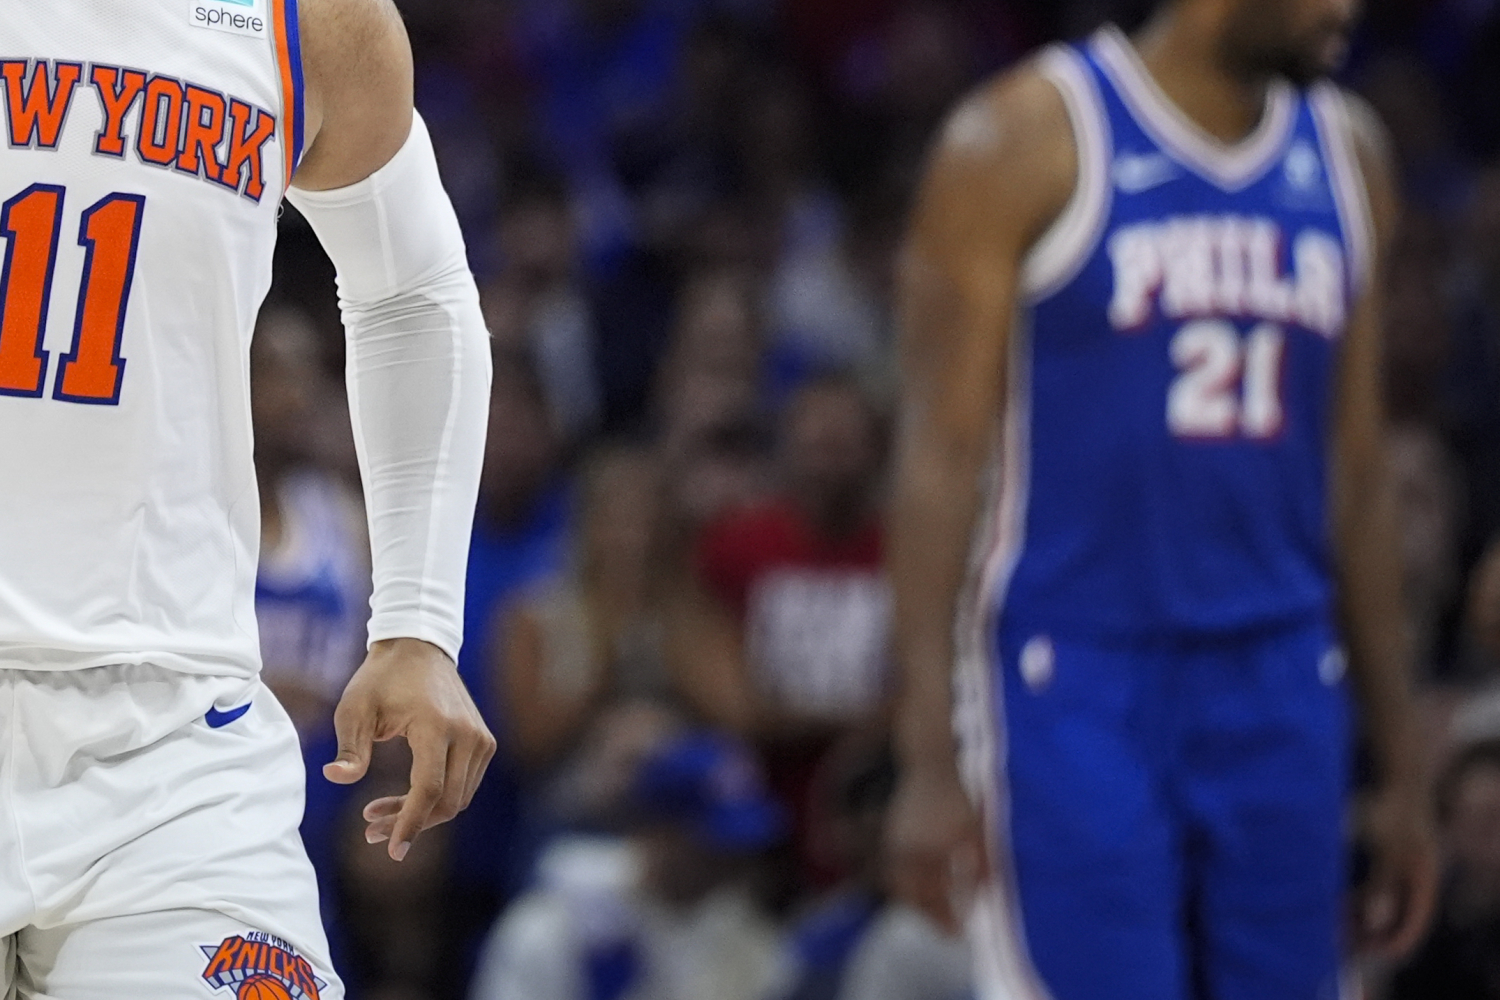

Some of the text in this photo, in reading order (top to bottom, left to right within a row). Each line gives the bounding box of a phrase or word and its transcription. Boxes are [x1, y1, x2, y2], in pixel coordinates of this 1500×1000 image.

[195, 7, 263, 32] sphere
[88, 60, 277, 205] YORK
[1106, 214, 1347, 339] PHILA
[1164, 315, 1286, 443] 21
[202, 934, 320, 1000] KNICKS
[246, 931, 270, 942] NEW
